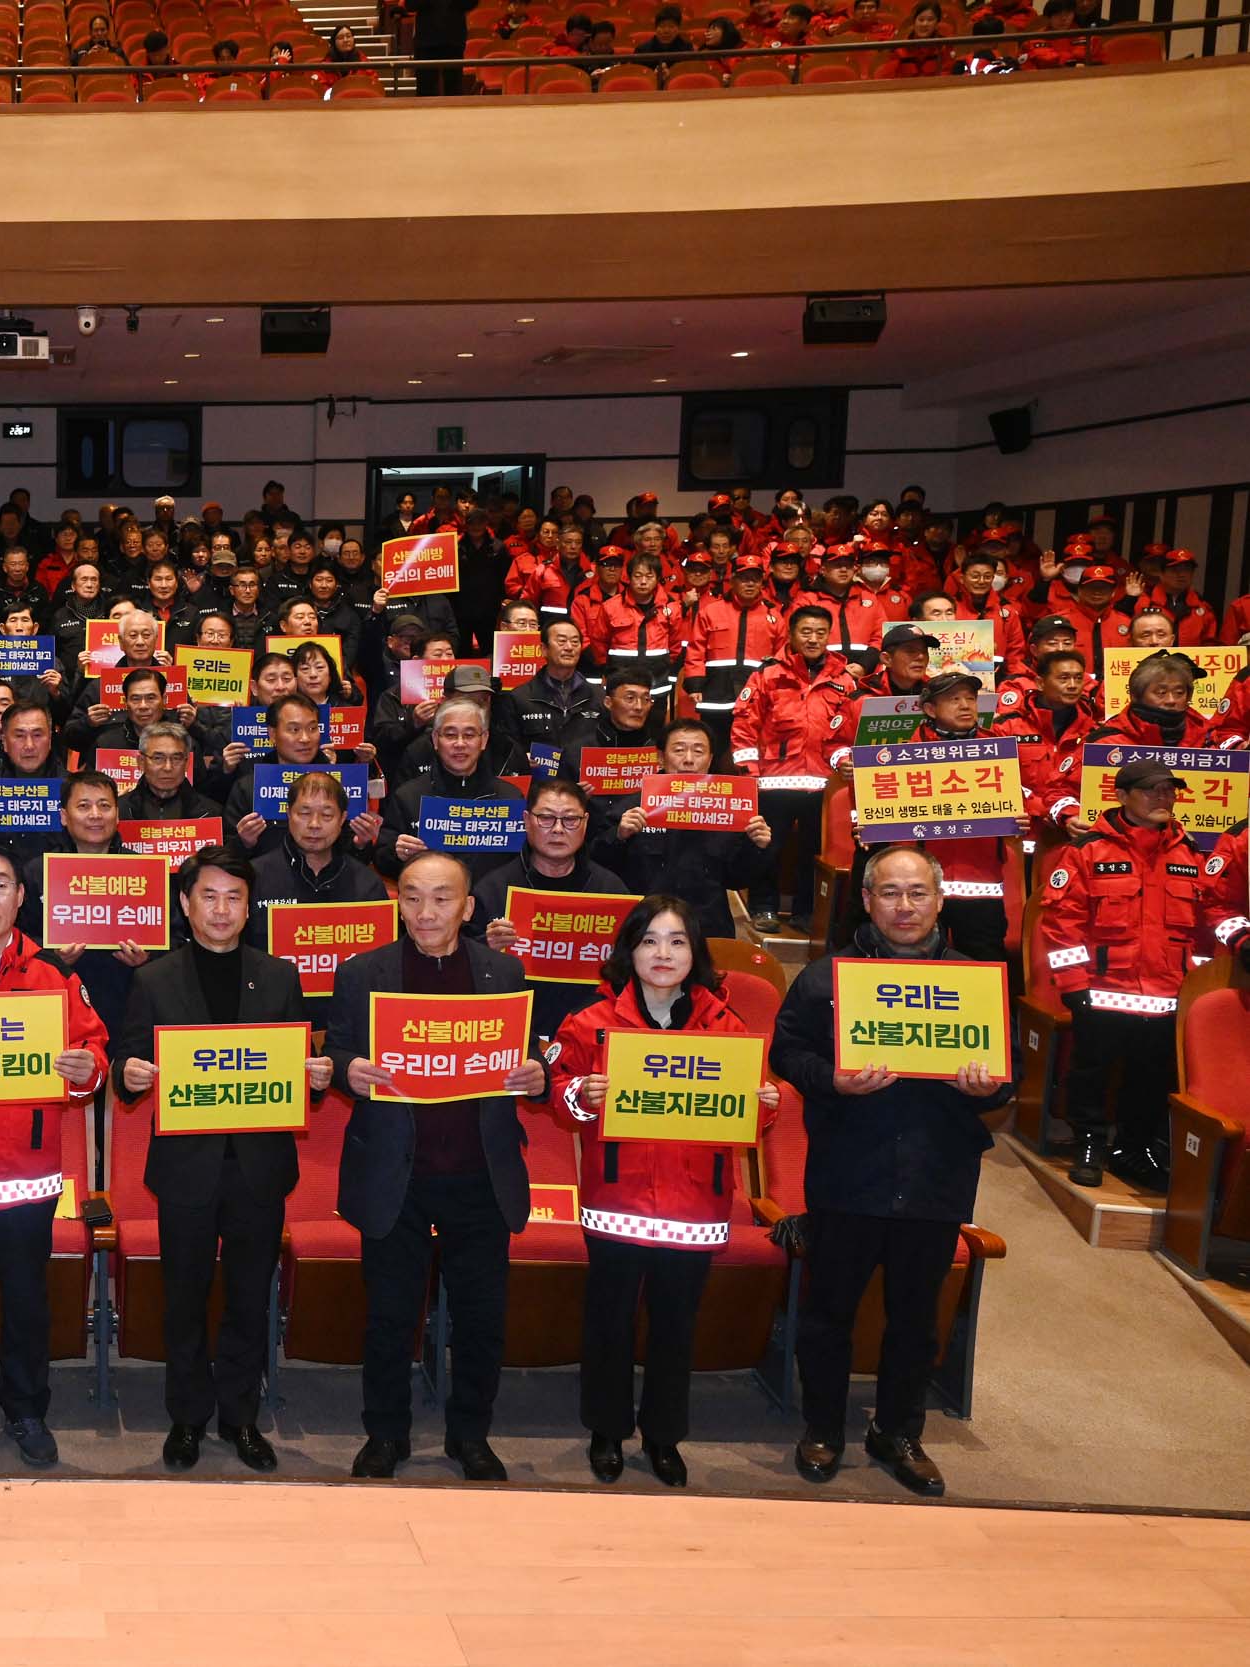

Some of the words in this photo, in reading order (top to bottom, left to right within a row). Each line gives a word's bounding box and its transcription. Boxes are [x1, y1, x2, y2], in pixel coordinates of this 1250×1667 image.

[384, 568, 421, 584] 우리의
[425, 565, 454, 579] 손에!
[8, 651, 34, 660] 태우지
[36, 651, 51, 660] 말고
[193, 659, 231, 673] 우리는
[500, 663, 537, 677] 우리의
[1110, 660, 1132, 676] 산불
[105, 684, 123, 693] 이제
[237, 725, 268, 736] 이제는
[342, 725, 359, 733] 말고
[606, 753, 659, 764] 영농부산물
[896, 743, 998, 762] 소각행위금지
[586, 766, 619, 777] 이제는
[621, 766, 654, 776] 태우지
[670, 780, 733, 794] 영농부산물
[872, 766, 1004, 799] 불법소각
[7, 800, 43, 812] 태우지
[647, 795, 684, 808] 이제는
[688, 796, 726, 810] 태우지
[730, 798, 753, 811] 말고
[864, 807, 895, 820] 당신의
[898, 805, 929, 818] 생명도
[933, 803, 953, 816] 태울
[957, 803, 967, 815] 수
[971, 800, 1017, 814] 있습니다.
[449, 806, 510, 818] 영농부산물
[666, 810, 733, 825] 파쇄하세요!
[140, 826, 196, 838] 영농부산물
[425, 818, 462, 832] 이제는
[465, 821, 502, 832] 태우지
[505, 821, 527, 832] 말고
[157, 840, 191, 852] 태우지
[443, 834, 508, 846] 파쇄하세요!
[68, 874, 148, 896] 산불예방
[52, 904, 111, 926] 우리의
[117, 904, 162, 926] 손에!
[531, 910, 617, 935] 산불예방
[294, 924, 376, 946] 산불예방
[510, 937, 574, 961] 우리의
[876, 983, 961, 1012] 우리는
[401, 1017, 505, 1044] 산불예방
[849, 1020, 991, 1051] 산불지킴이
[192, 1048, 268, 1072] 우리는
[380, 1051, 456, 1077] 우리의
[463, 1049, 519, 1076] 손에!
[642, 1054, 722, 1081] 우리는
[168, 1080, 292, 1109] 산불지킴이
[614, 1089, 746, 1119] 산불지킴이
